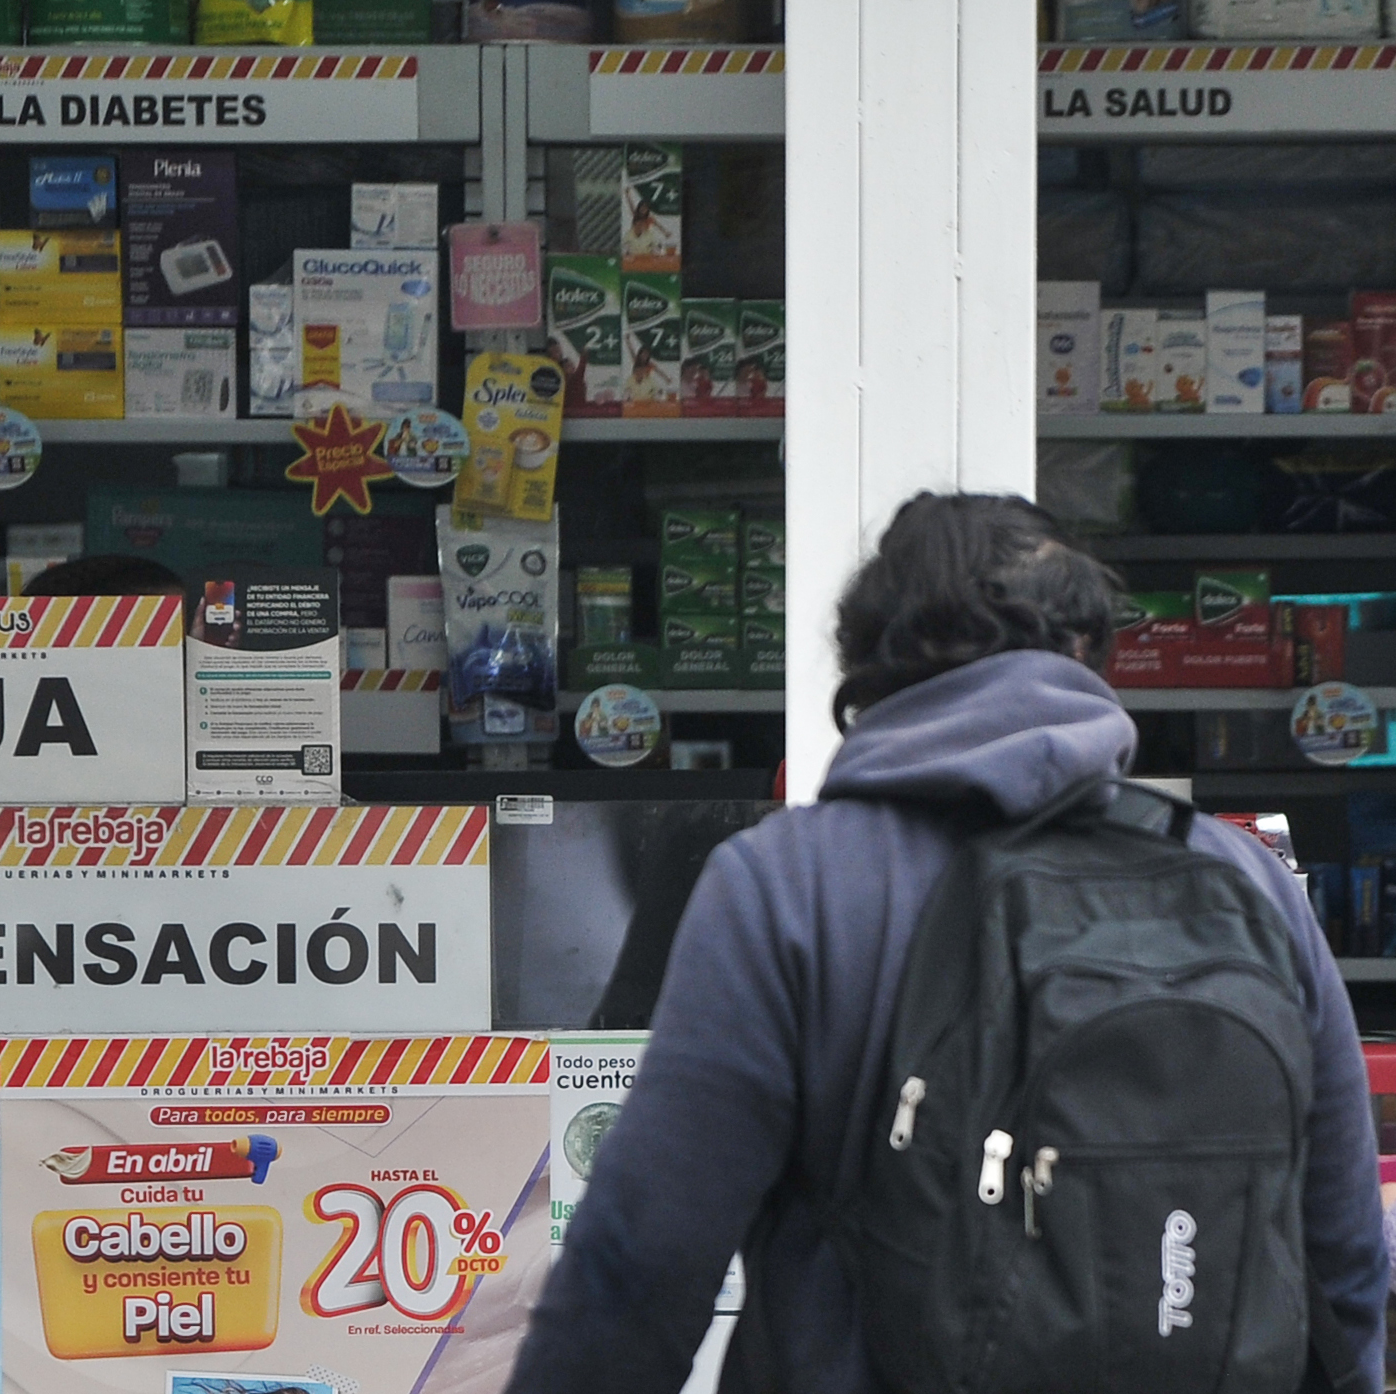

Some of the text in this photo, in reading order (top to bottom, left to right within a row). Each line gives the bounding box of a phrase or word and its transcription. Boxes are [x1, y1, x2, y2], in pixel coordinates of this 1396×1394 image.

[61, 93, 267, 128] DIABETES
[1044, 87, 1233, 118] LA SALUD
[153, 159, 201, 178] Plenia
[303, 258, 424, 276] GlucoQuick
[97, 870, 231, 879] MINIMARKETS
[556, 1056, 636, 1071] Todo peso
[557, 1071, 636, 1089] cuenta
[141, 1086, 399, 1096] DROGUERIAS MINIMARKETS
[158, 1105, 385, 1125] Para todos, para siempre
[107, 1146, 211, 1174] En abril
[371, 1169, 438, 1182] HASTA EL
[120, 1187, 203, 1204] Cuida tu
[63, 1213, 246, 1260] Cabello
[457, 1258, 499, 1272] DCTO
[83, 1268, 250, 1294] y consiente tu
[123, 1293, 214, 1342] Piel
[383, 1324, 465, 1335] Seleccionadas
